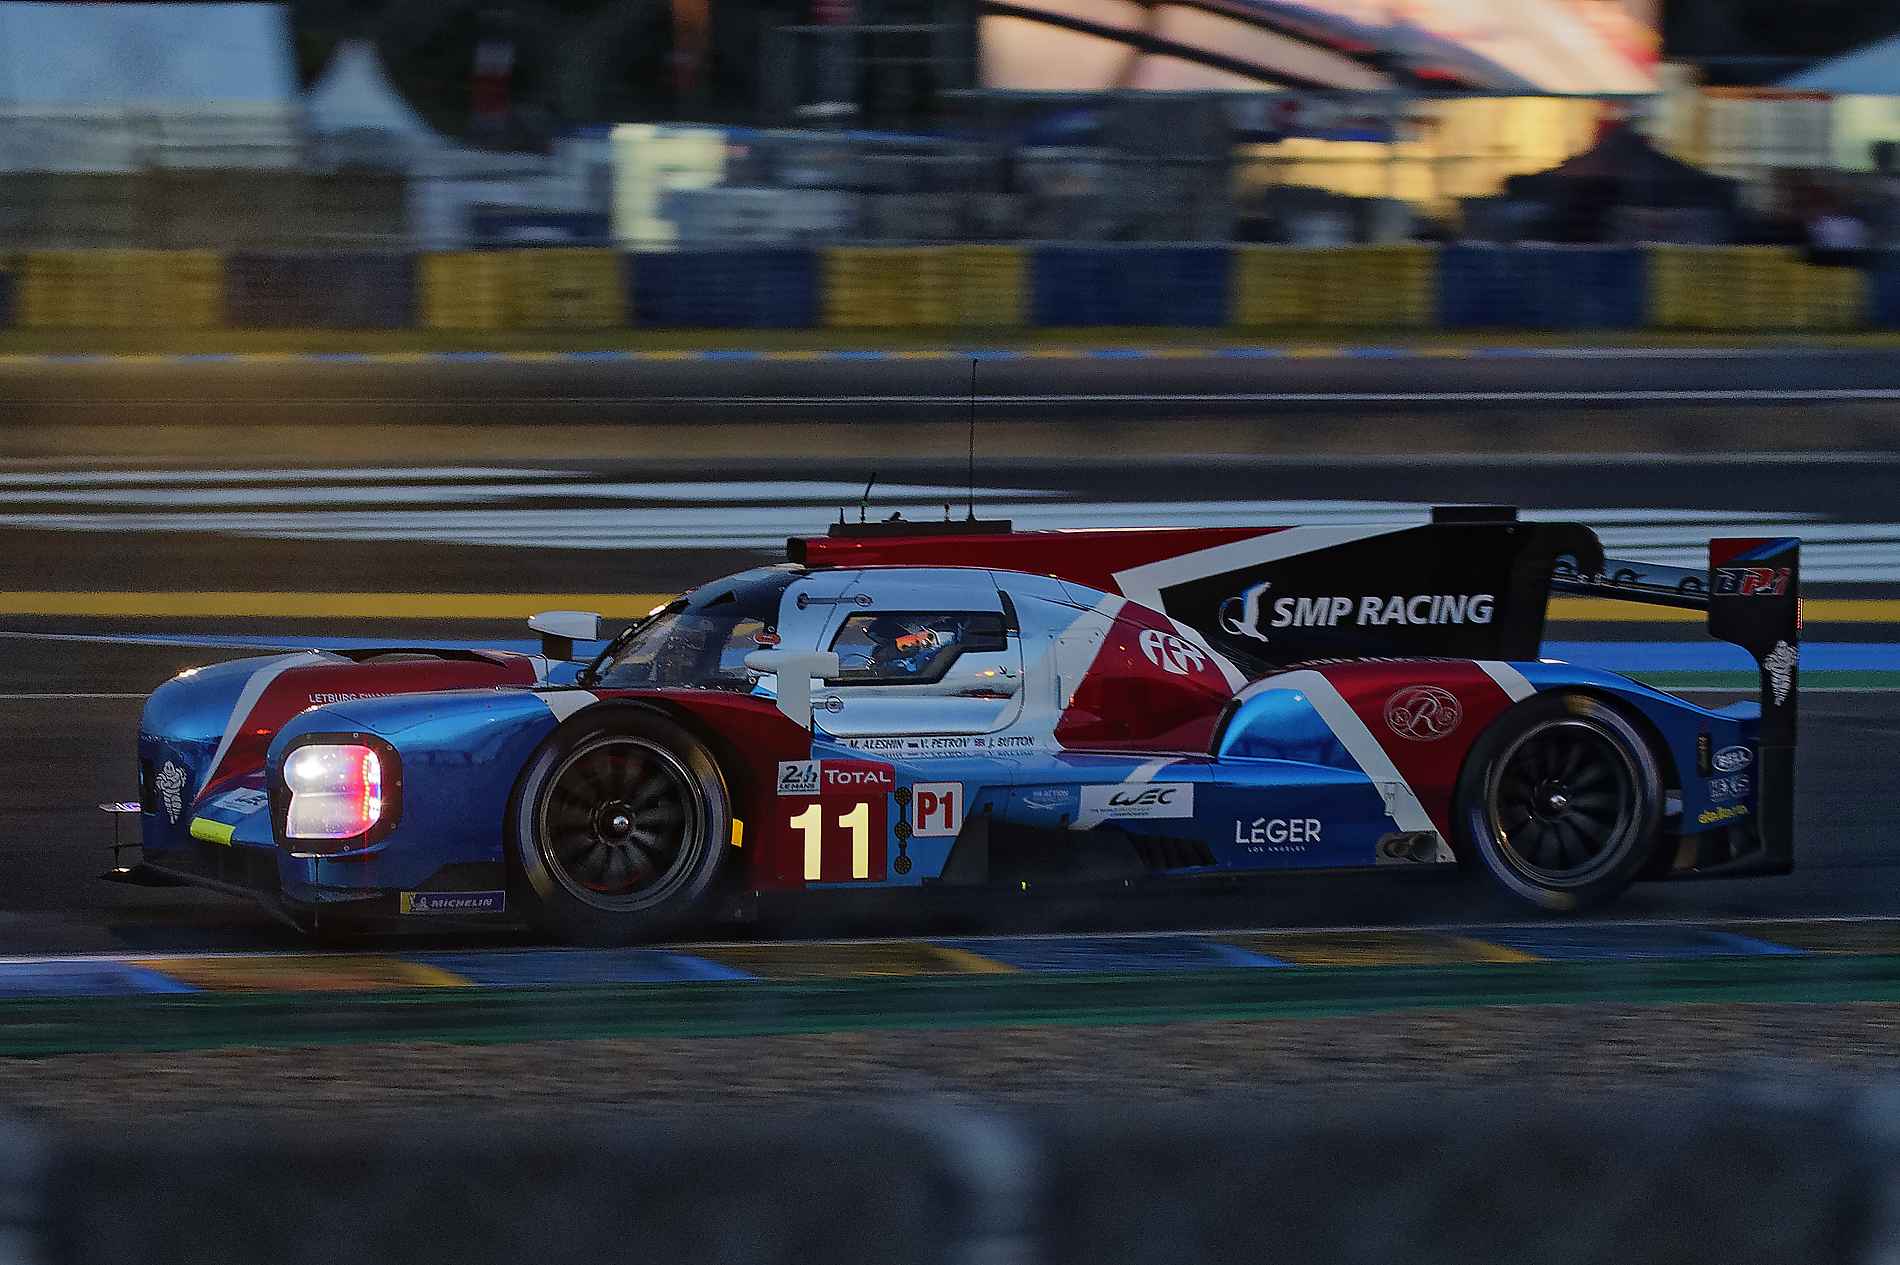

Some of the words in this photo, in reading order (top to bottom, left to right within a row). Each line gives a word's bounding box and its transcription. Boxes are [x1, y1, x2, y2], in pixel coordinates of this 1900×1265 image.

[1271, 596, 1352, 627] SMP
[1358, 594, 1495, 626] RACING
[863, 738, 903, 750] ALESHIN
[931, 738, 969, 749] PETROV
[997, 736, 1034, 747] BUTTON
[1109, 788, 1177, 806] WEC
[917, 791, 954, 830] P1
[1234, 816, 1322, 844] LÉGER
[789, 803, 869, 880] 11
[431, 897, 493, 909] MICHELIN
